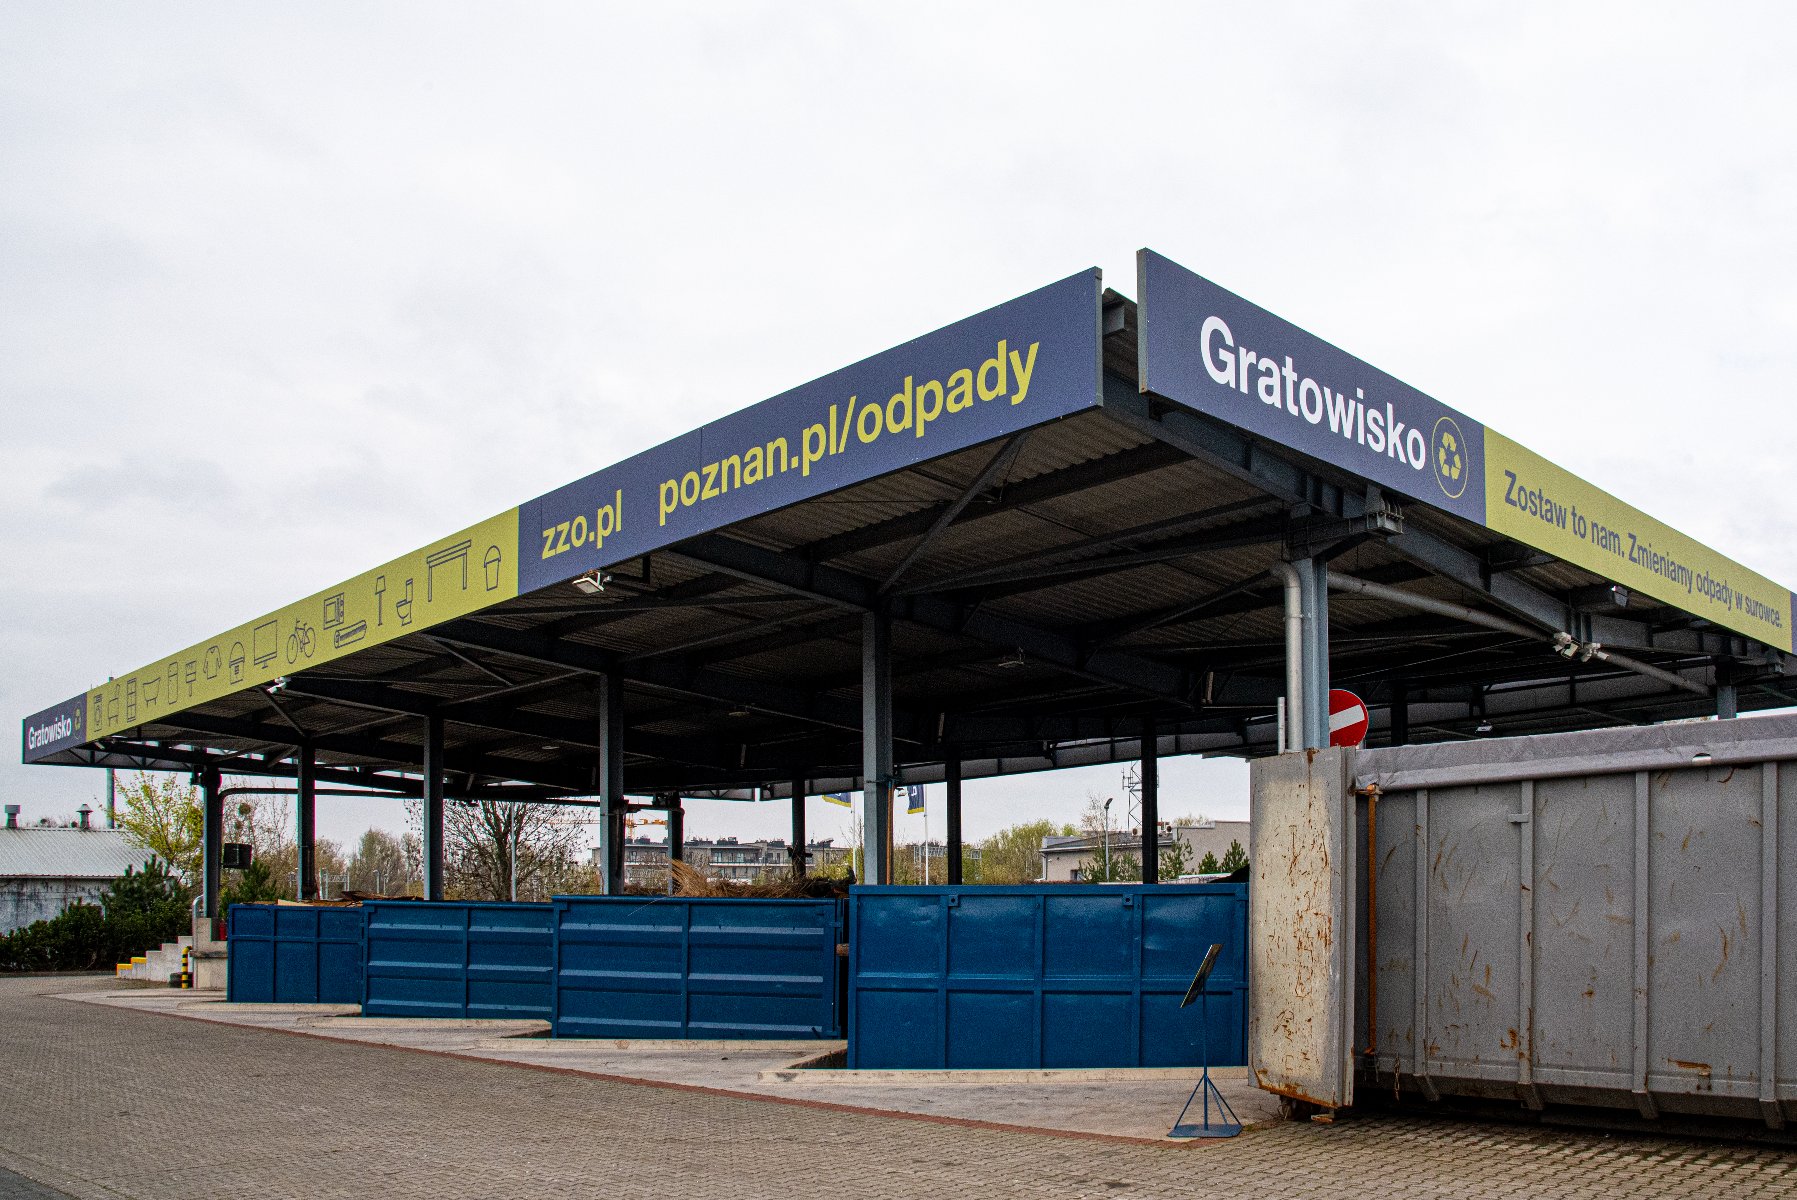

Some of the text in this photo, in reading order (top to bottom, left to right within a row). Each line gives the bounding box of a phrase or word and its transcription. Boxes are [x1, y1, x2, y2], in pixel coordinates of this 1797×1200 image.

[542, 340, 1039, 559] zzo.pl poznan.pl/odpady
[1201, 315, 1426, 470] Gratowisko
[1504, 469, 1783, 628] Zostaw to nam. Zmieniamy odpady w surowce.
[28, 714, 72, 750] Gratowisko
